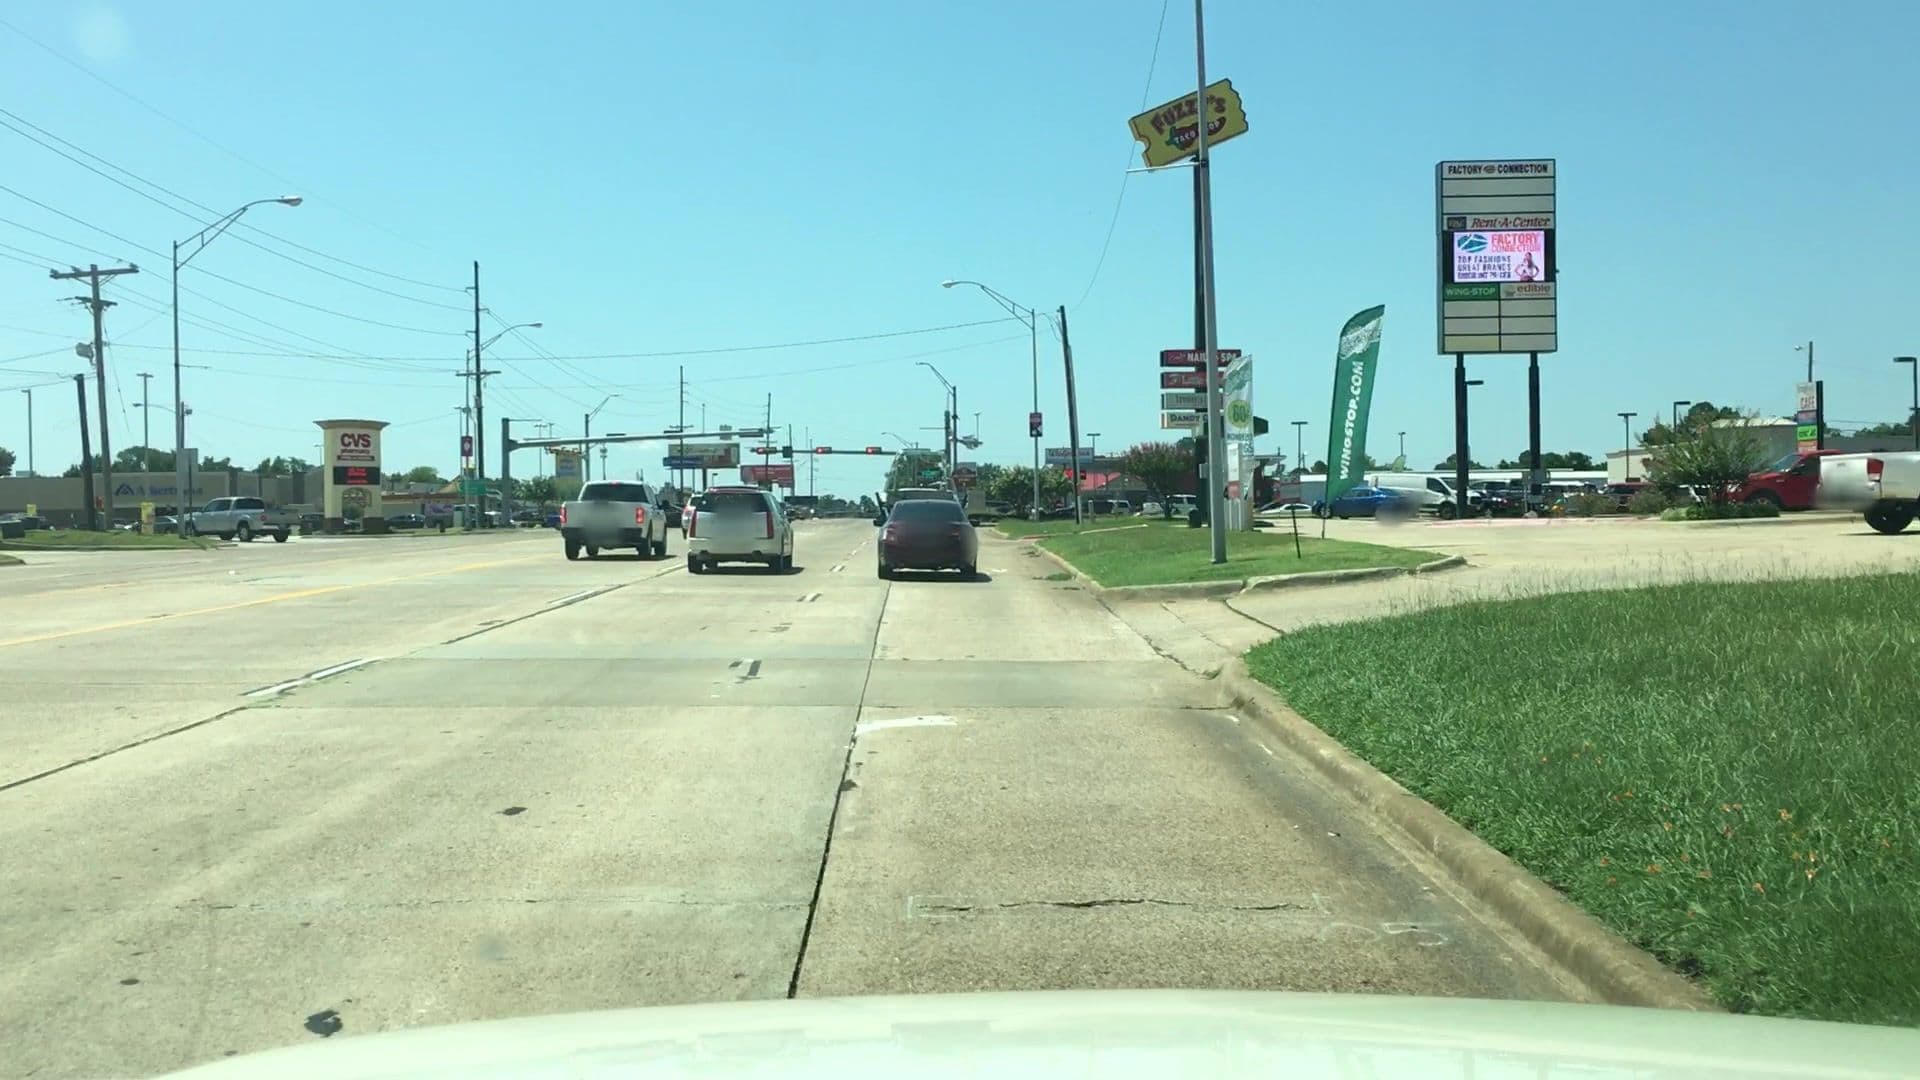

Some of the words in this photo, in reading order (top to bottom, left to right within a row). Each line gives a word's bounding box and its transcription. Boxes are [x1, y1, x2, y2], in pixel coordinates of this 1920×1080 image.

[1174, 130, 1197, 144] TACO
[1448, 165, 1482, 175] FACTORY
[1497, 163, 1548, 174] CONNECTION
[1491, 233, 1538, 245] FACTORY
[1474, 255, 1512, 264] FASHIONS
[1457, 263, 1481, 272] GREAT
[1482, 263, 1512, 272] BRANDS
[1517, 283, 1551, 292] edible
[1339, 361, 1364, 480] WINGSTOP.COM
[340, 432, 371, 448] CVS
